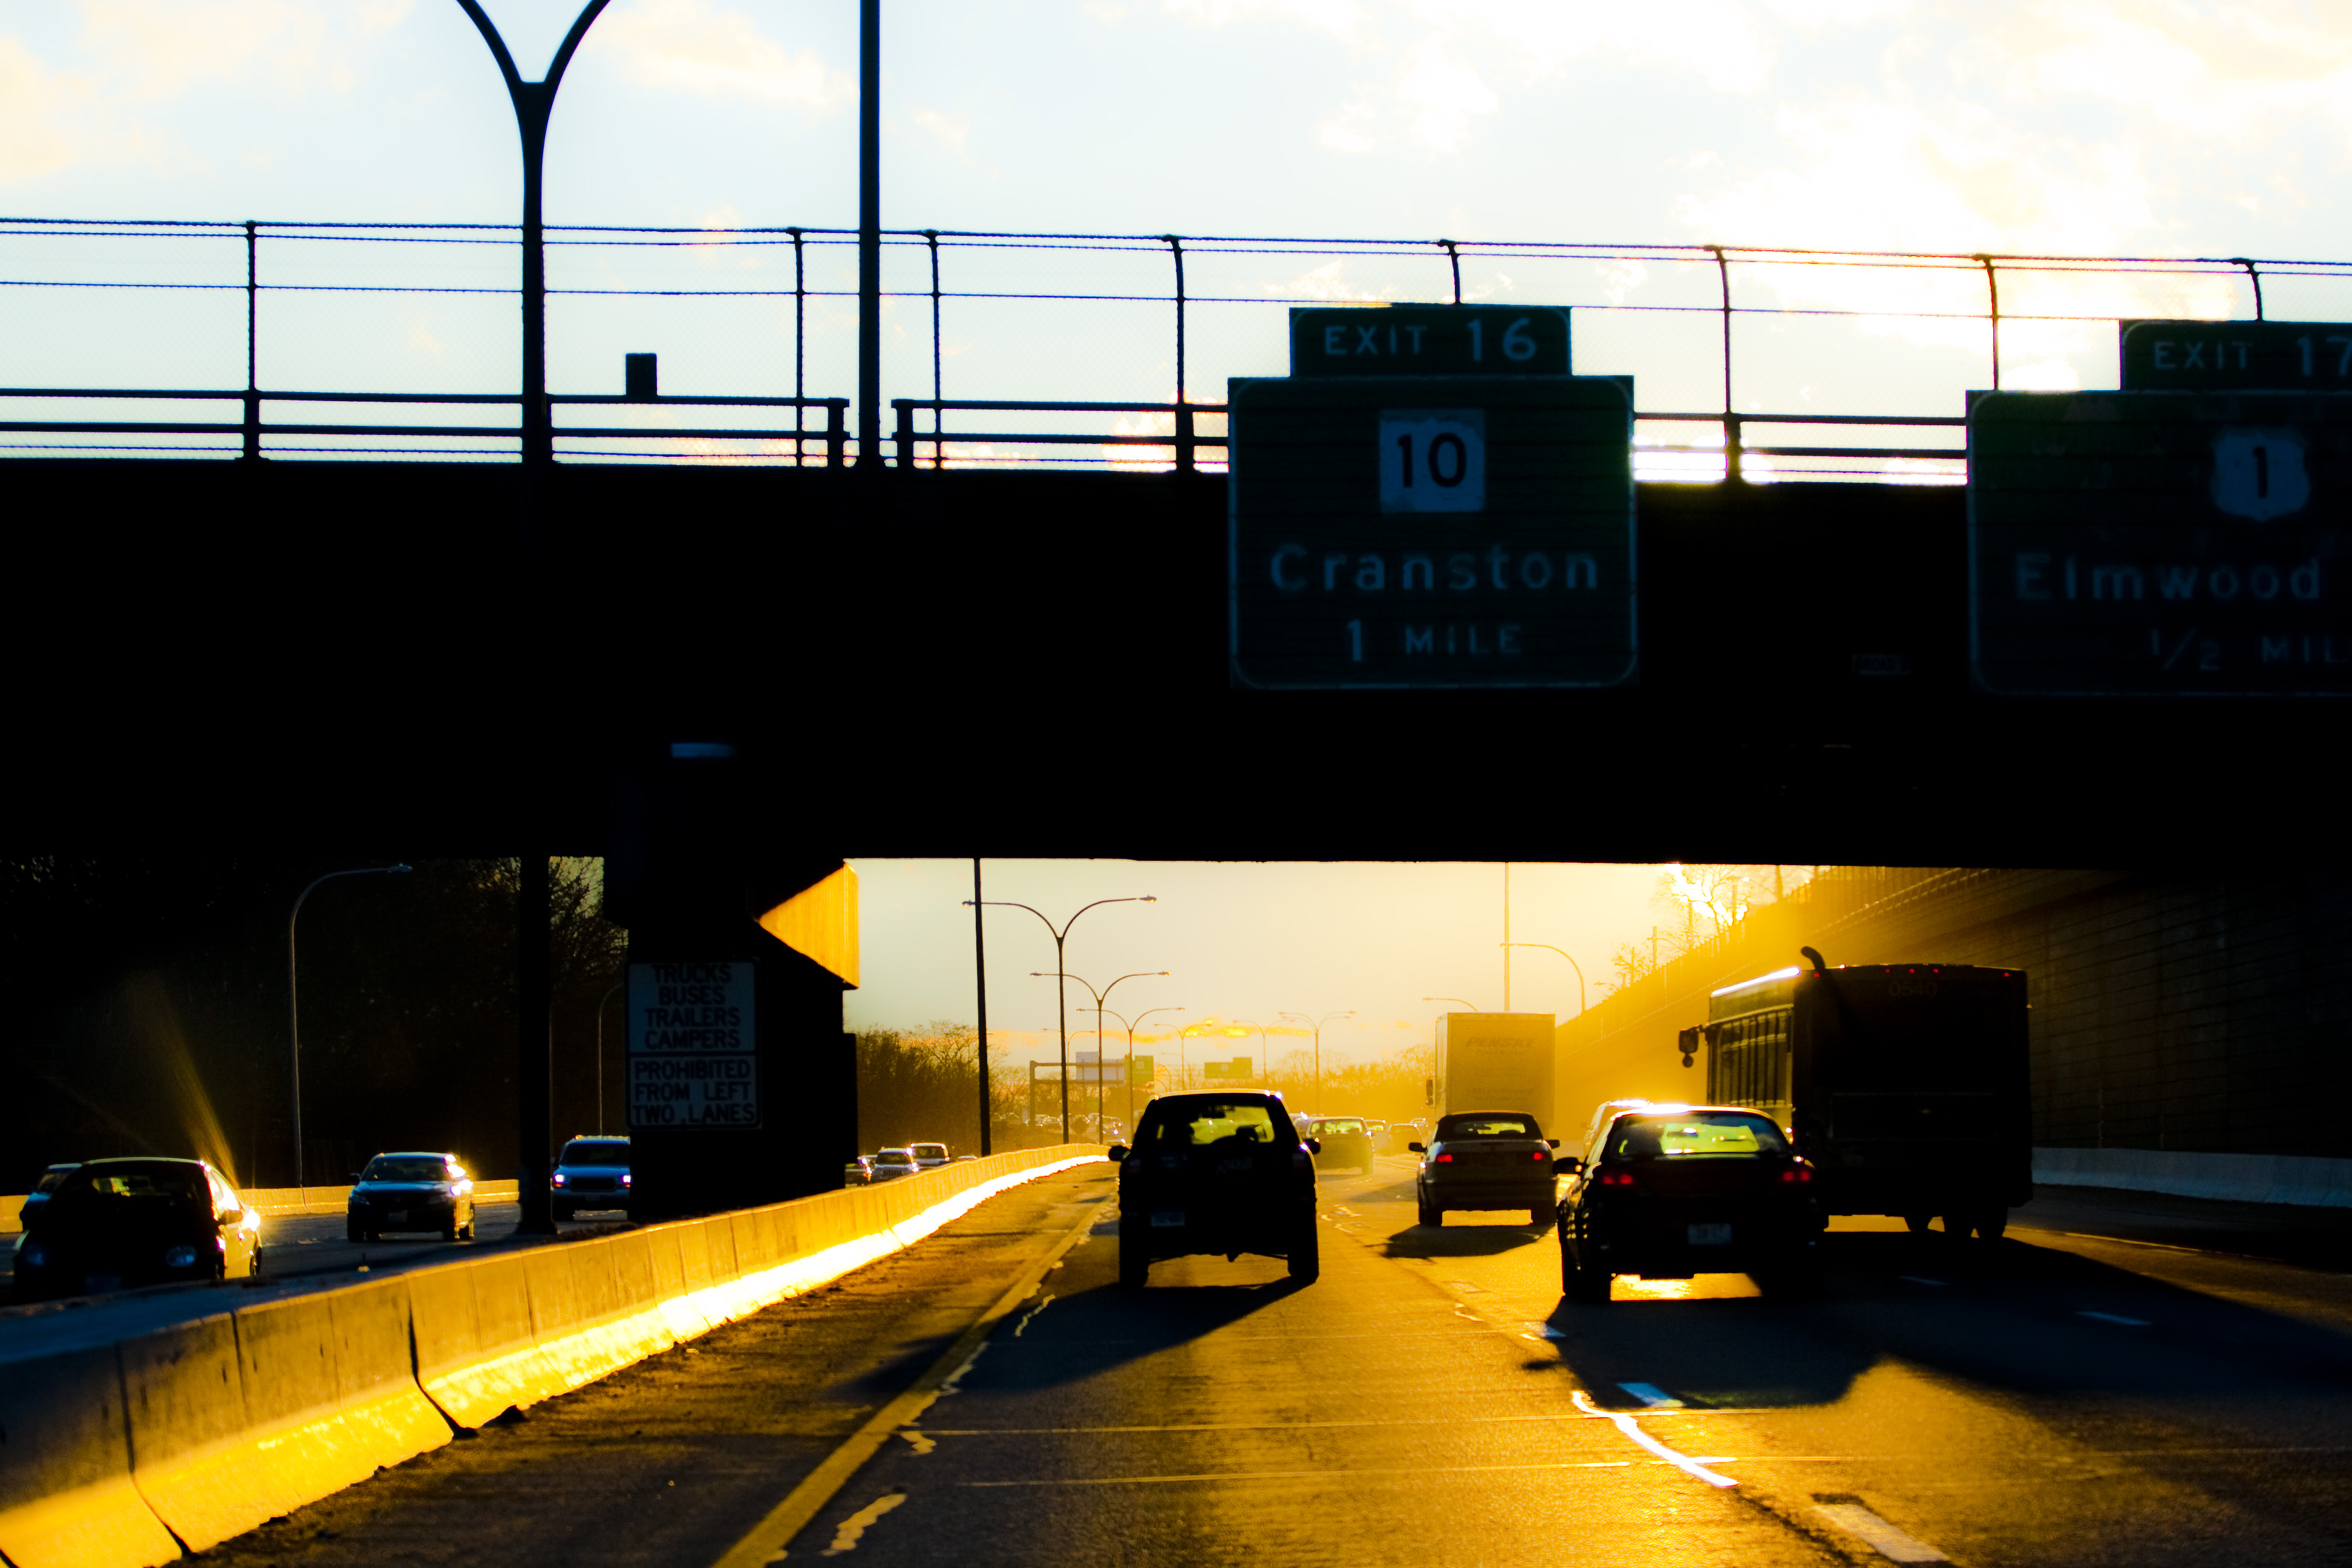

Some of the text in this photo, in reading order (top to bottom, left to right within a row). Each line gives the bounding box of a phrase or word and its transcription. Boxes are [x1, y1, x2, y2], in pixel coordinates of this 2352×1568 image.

[1324, 317, 1538, 362] EXIT 16
[2154, 339, 2253, 370] EXIT
[1397, 432, 1466, 488] 10
[2253, 446, 2267, 498] 1
[1270, 543, 1598, 592] Cranston
[2015, 553, 2321, 601] Elmwood
[1346, 618, 1523, 662] 1 MILE
[2261, 633, 2352, 664] MIL
[652, 963, 732, 984] TRUCKS
[659, 985, 725, 1005] BUSES
[1888, 981, 1938, 997] 0540
[645, 1007, 740, 1028] TRAILERS
[644, 1028, 740, 1050] CAMPERS
[635, 1059, 751, 1080] PROHIBITED
[635, 1081, 751, 1102] FROM LEFT
[632, 1103, 754, 1124] TWO LANES
